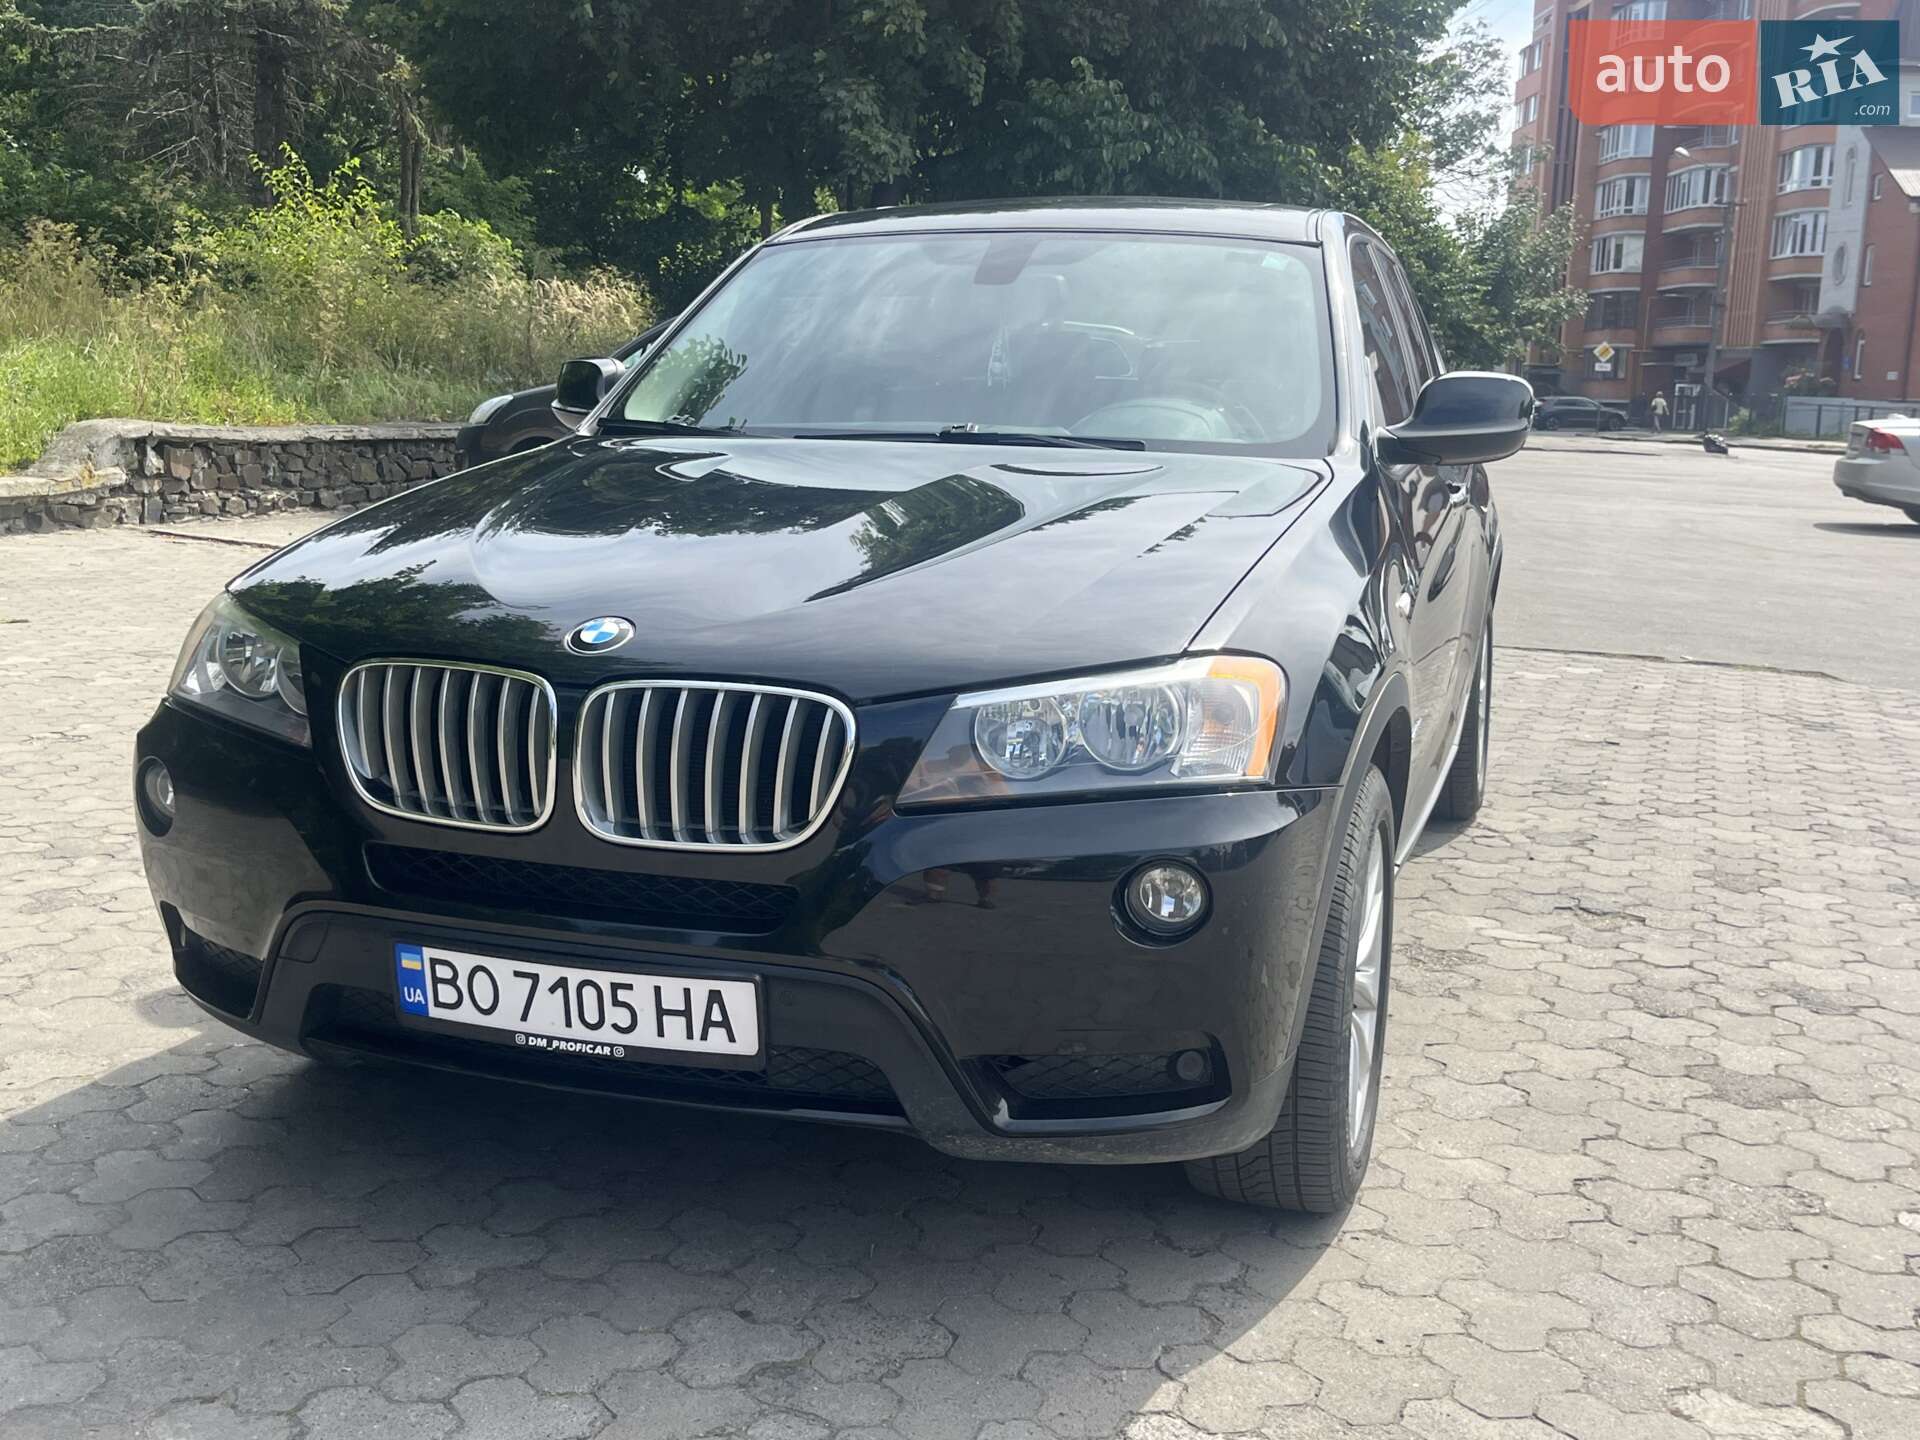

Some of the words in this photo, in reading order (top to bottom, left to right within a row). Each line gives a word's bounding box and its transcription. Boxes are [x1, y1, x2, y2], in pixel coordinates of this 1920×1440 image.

[403, 986, 426, 1005] UA
[429, 956, 500, 1016] BO
[513, 970, 638, 1035] 7105
[653, 984, 737, 1044] HA
[528, 1036, 611, 1056] DM_PROFICAR
